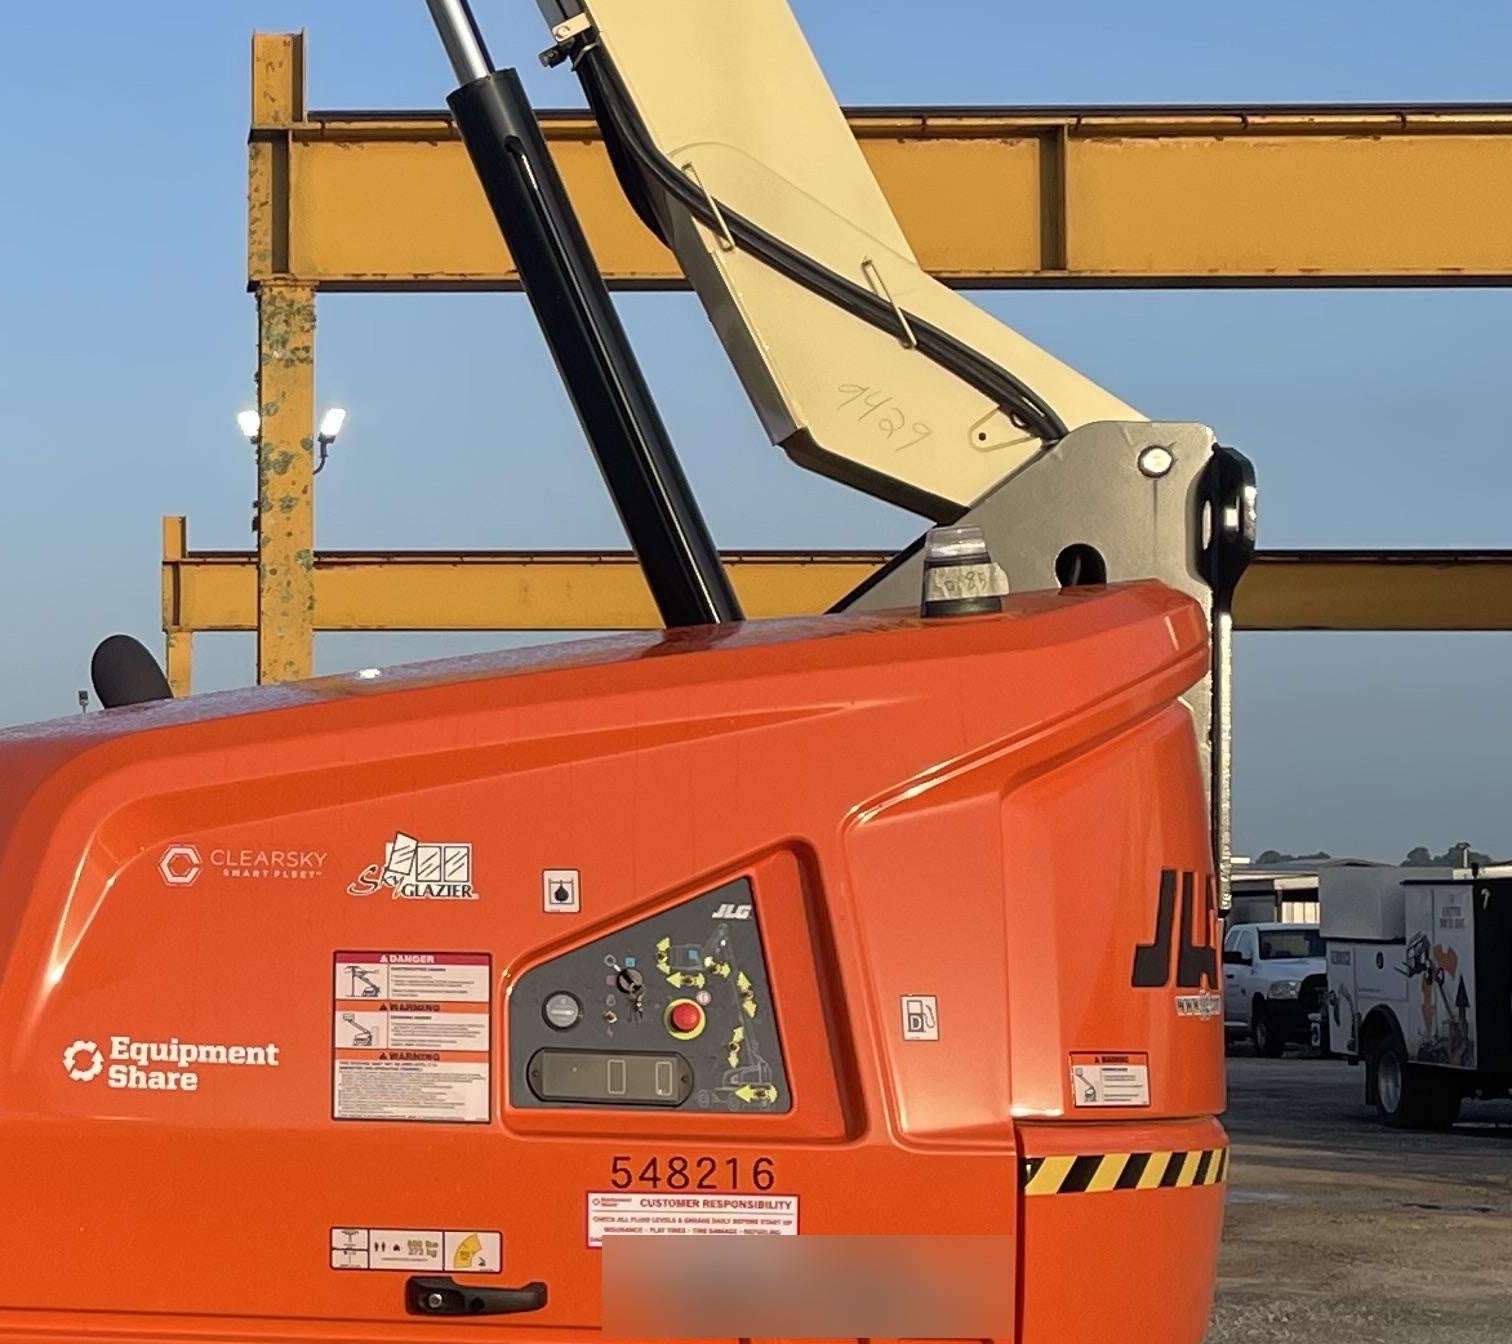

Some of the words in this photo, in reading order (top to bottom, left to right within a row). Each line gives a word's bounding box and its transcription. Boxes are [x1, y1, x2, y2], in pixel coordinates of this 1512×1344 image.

[210, 848, 328, 868] CLEARSKY
[401, 882, 473, 899] GLAZIER
[712, 904, 752, 920] JLG
[1131, 869, 1220, 990] JL
[389, 954, 435, 964] DANGER
[109, 1036, 280, 1068] Equipment
[107, 1064, 200, 1091] Share
[610, 1156, 775, 1191] 548216
[639, 1198, 700, 1209] CUSTOMER
[702, 1199, 792, 1210] RESPONSIBILITY
